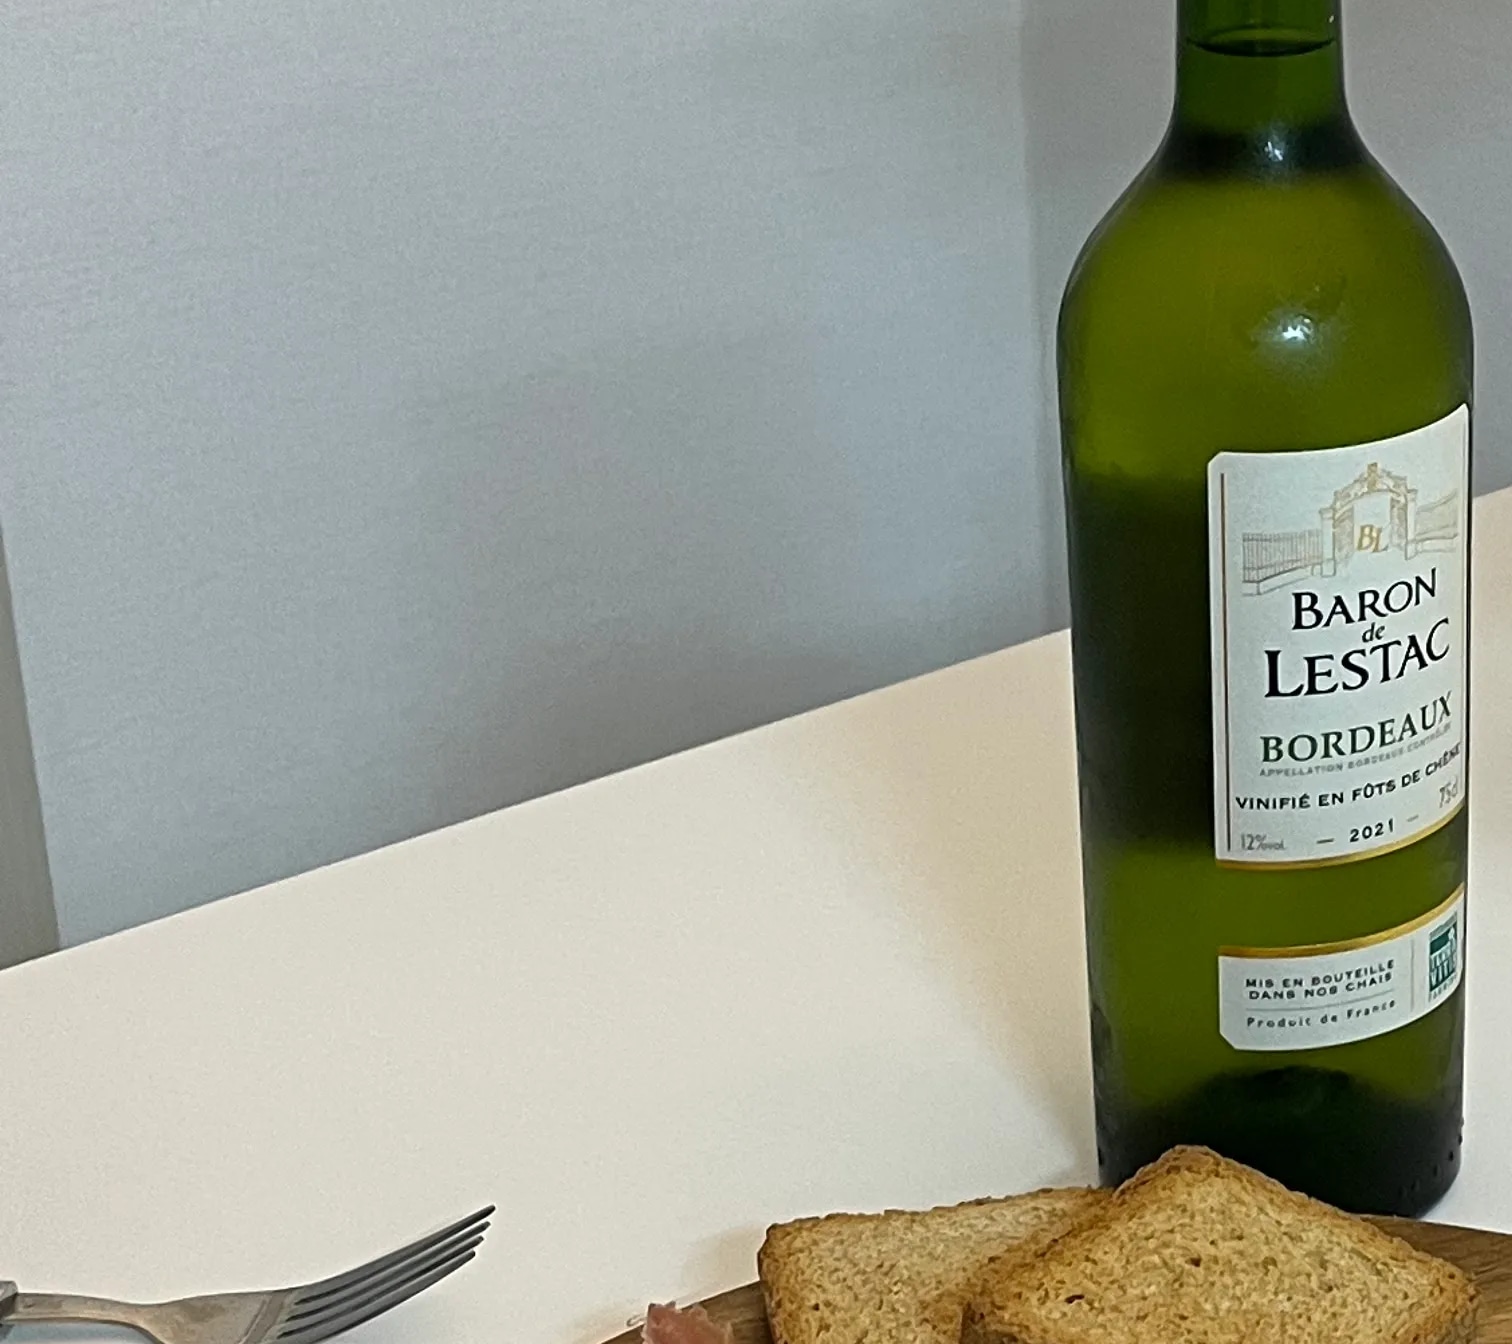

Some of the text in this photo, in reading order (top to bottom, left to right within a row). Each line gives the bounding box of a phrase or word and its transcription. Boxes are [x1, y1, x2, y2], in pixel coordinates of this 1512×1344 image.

[1292, 567, 1437, 631] BARON
[1362, 622, 1385, 644] de
[1264, 618, 1449, 698] LESTAC
[1260, 690, 1451, 763] BORDEAUX
[1259, 763, 1344, 777] APPELLATION
[1235, 793, 1311, 811] VINIFIÉ
[1318, 791, 1345, 807] EN
[1352, 779, 1397, 803] FÔTS
[1401, 769, 1421, 788] DE
[1350, 818, 1394, 843] 2021
[1246, 959, 1394, 988] MIS EN BOUTEILLE
[1249, 972, 1392, 1000] DANS NOS CHAIS
[1247, 1000, 1396, 1028] Produit de France
